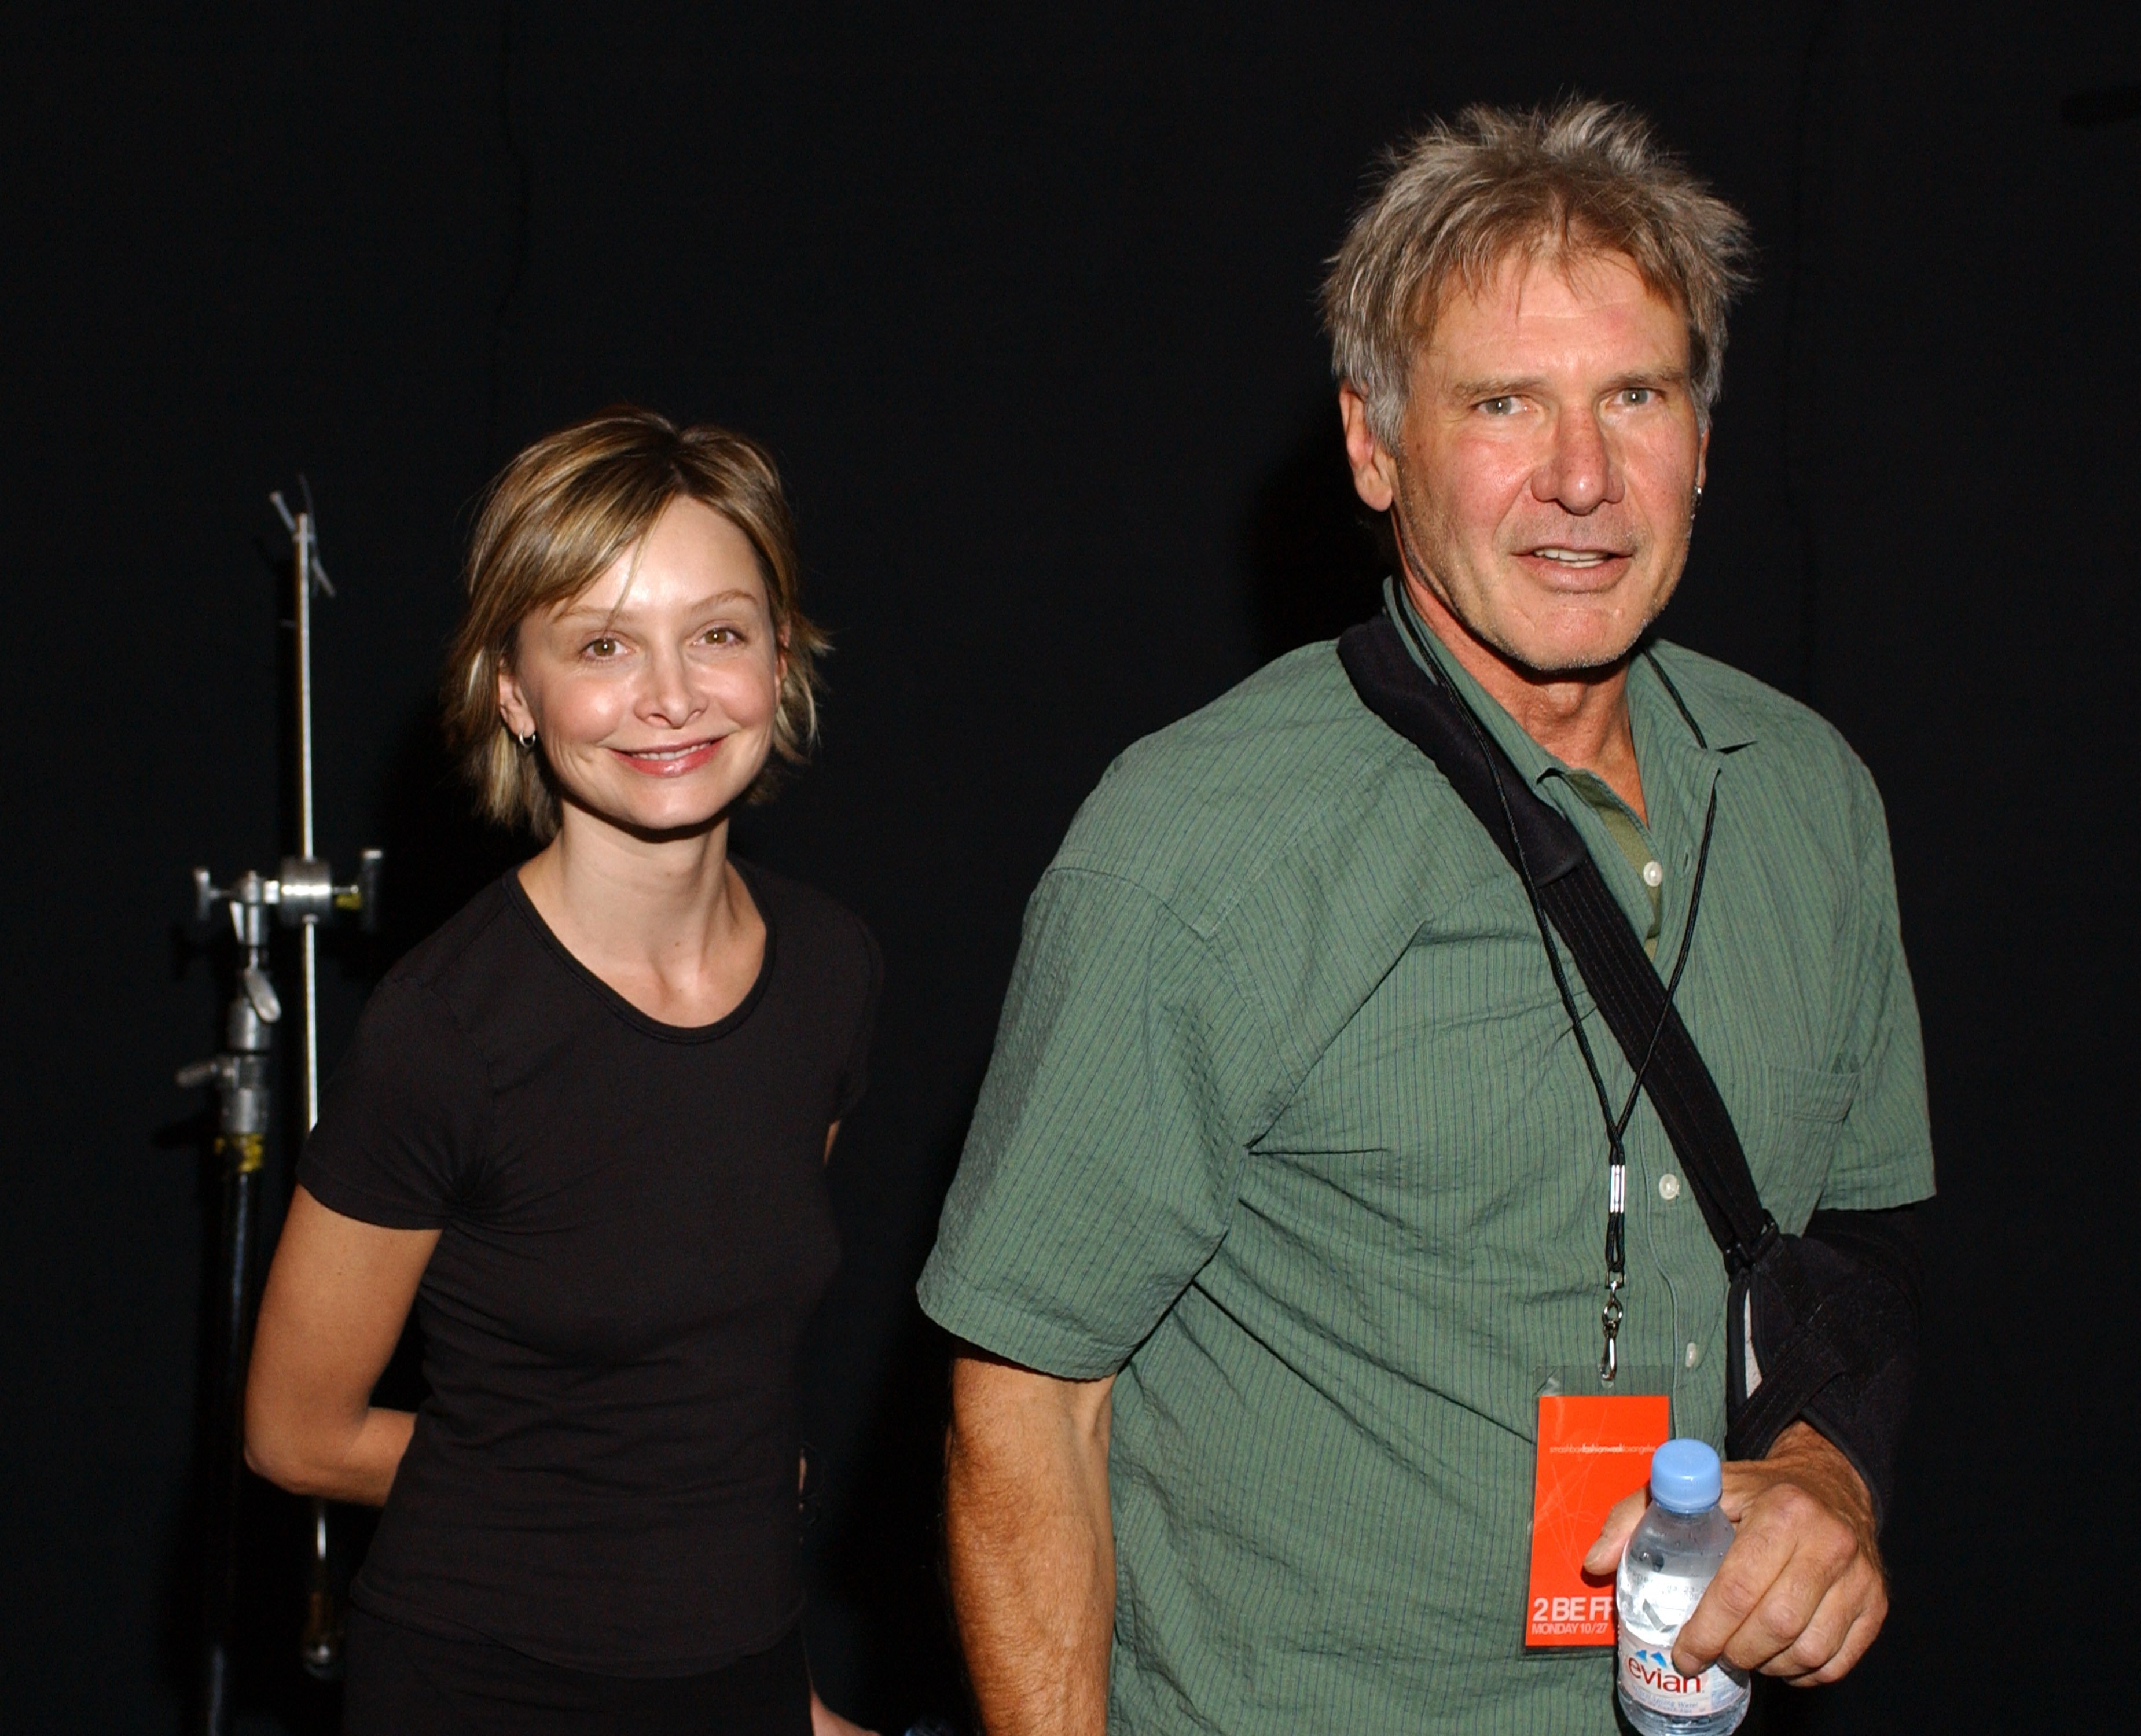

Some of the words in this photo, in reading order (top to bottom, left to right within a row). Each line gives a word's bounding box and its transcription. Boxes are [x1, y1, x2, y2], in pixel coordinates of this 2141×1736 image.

[1533, 1597, 1549, 1621] 2
[1552, 1597, 1585, 1621] BE
[1531, 1623, 1579, 1634] MONDAY
[1581, 1623, 1608, 1634] 10/27
[1628, 1657, 1701, 1694] evian
